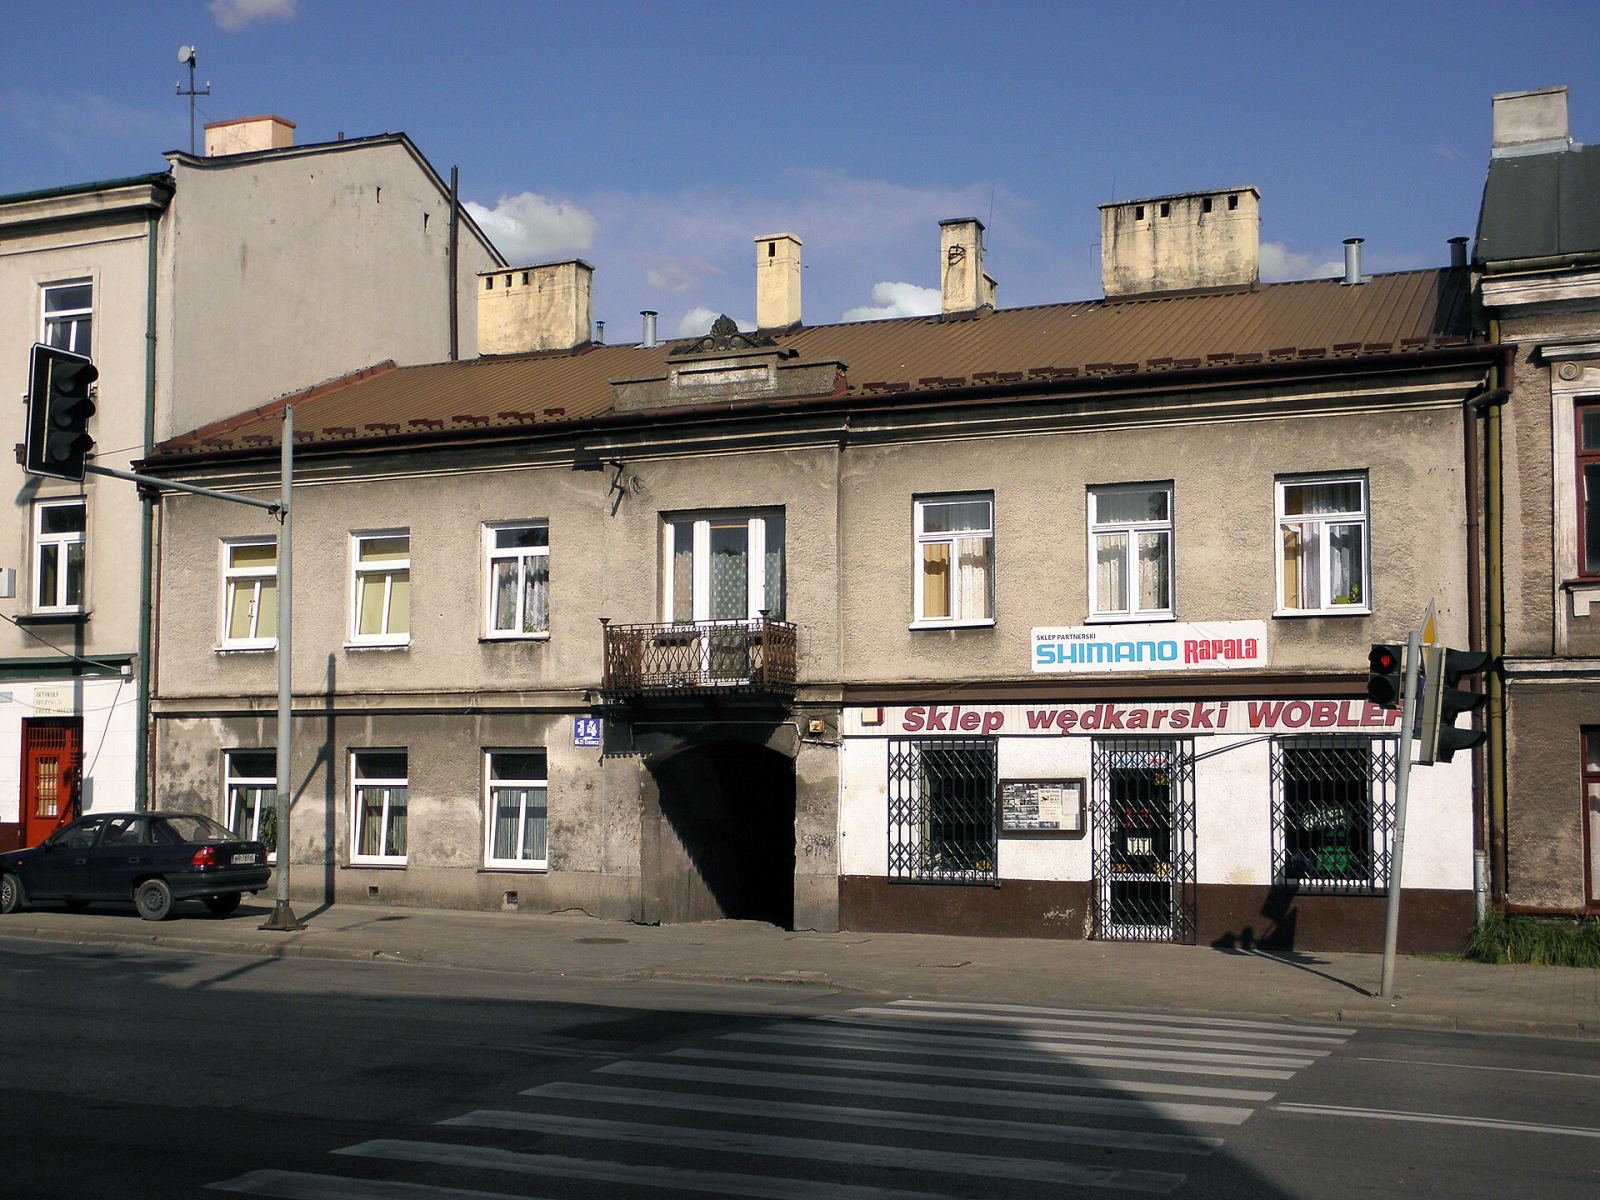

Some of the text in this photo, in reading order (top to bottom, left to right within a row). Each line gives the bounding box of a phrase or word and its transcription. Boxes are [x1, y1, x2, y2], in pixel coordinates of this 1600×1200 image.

[1036, 640, 1178, 665] SHIMANO
[577, 720, 597, 737] 14
[902, 706, 1005, 736] Sklep
[1027, 702, 1229, 737] wędkarski
